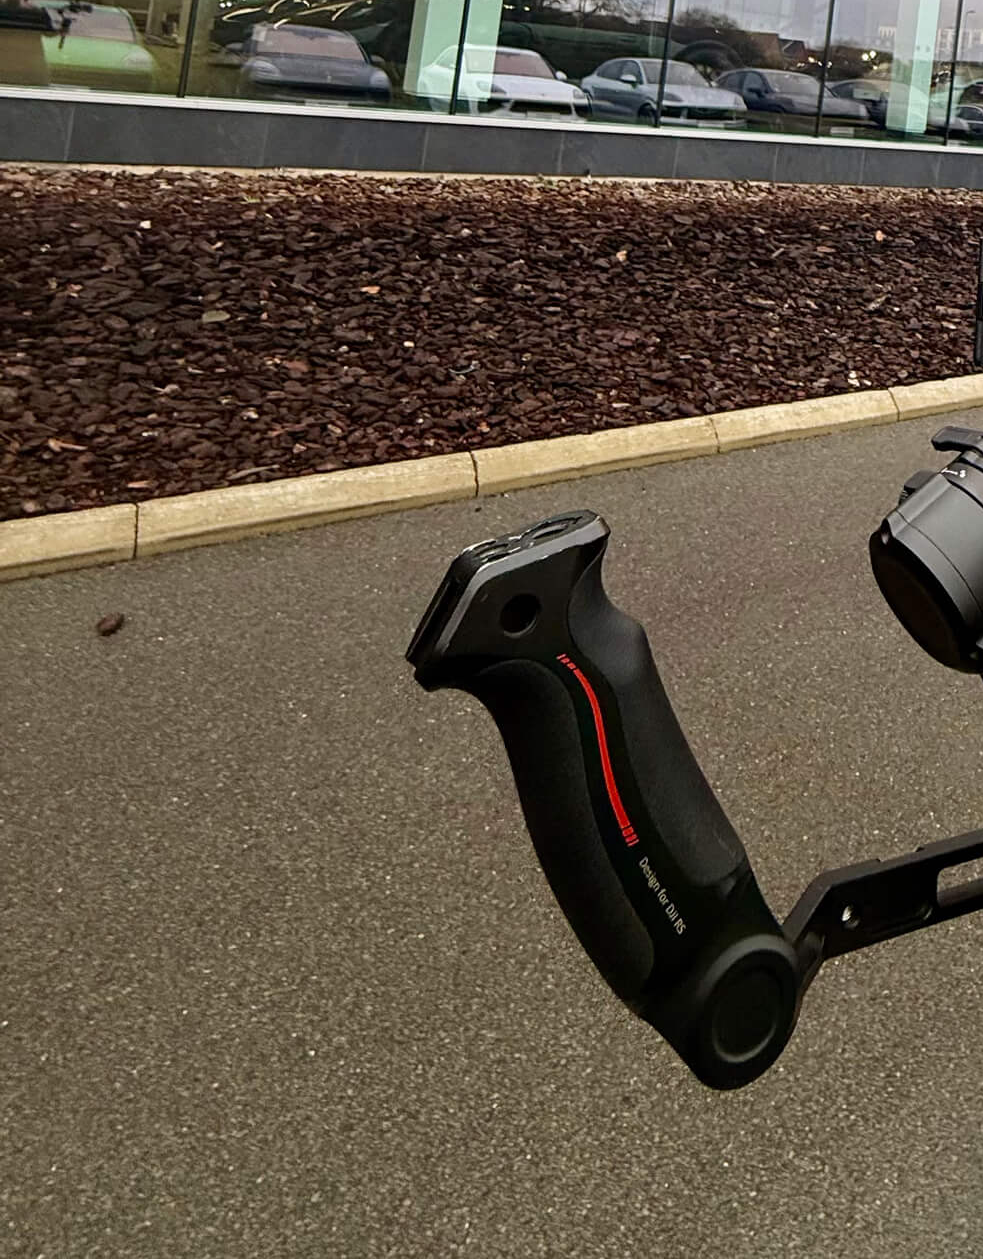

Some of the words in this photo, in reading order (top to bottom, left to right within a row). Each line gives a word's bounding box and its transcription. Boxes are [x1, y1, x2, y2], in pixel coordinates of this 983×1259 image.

[640, 856, 660, 892] Design
[657, 888, 670, 907] for
[665, 903, 680, 922] DJI
[674, 918, 686, 934] RS
